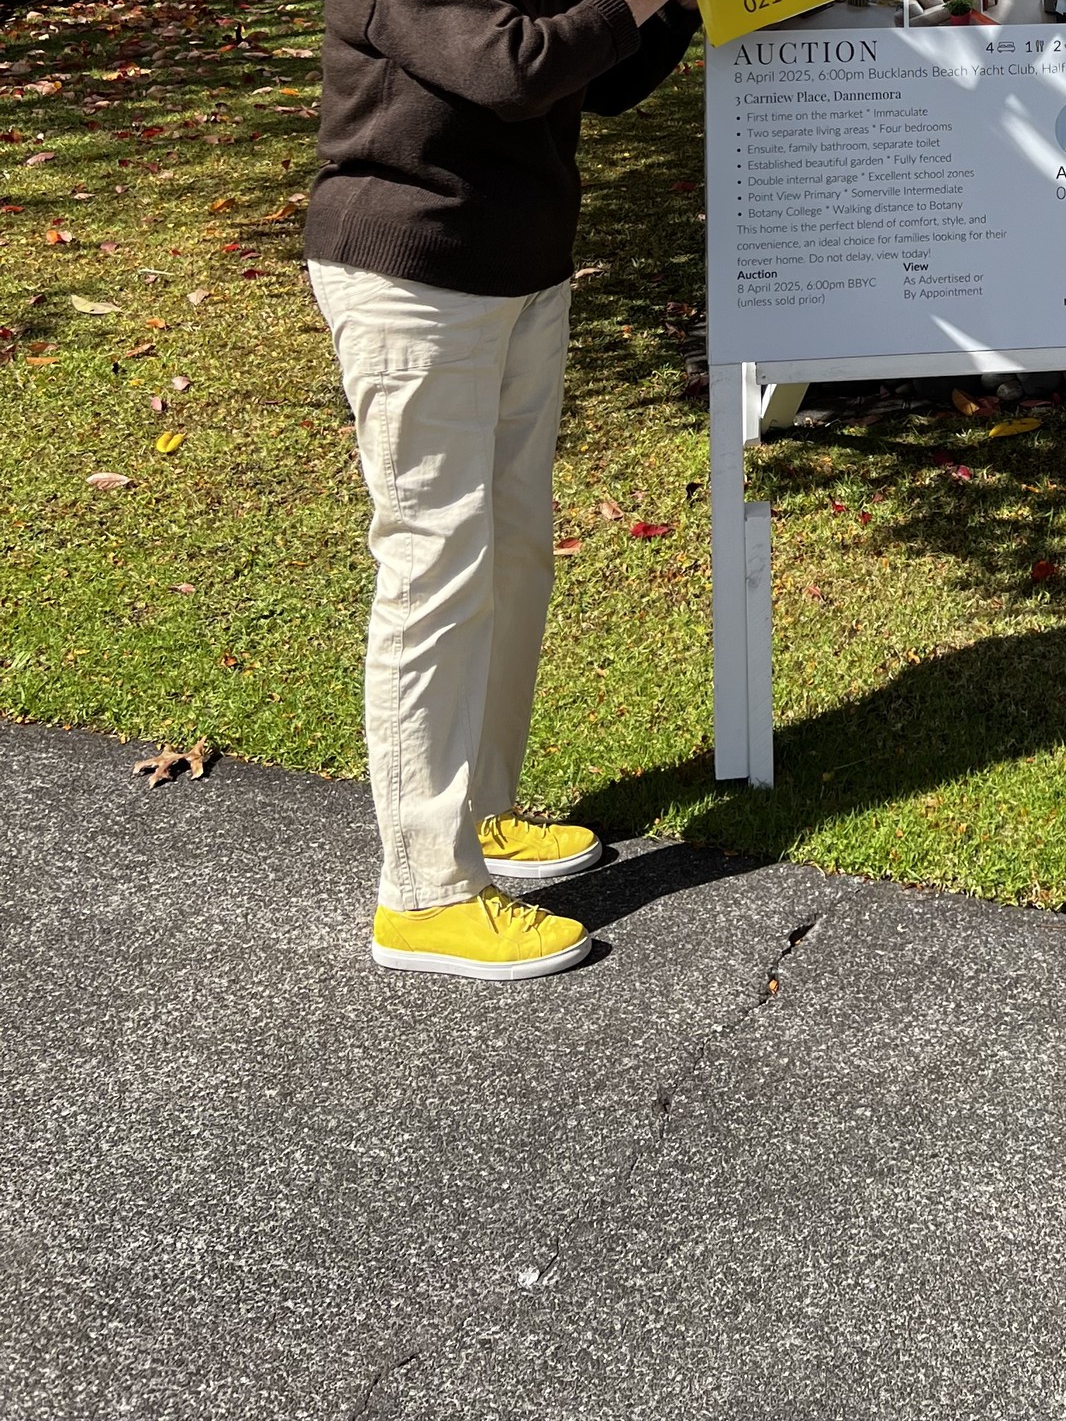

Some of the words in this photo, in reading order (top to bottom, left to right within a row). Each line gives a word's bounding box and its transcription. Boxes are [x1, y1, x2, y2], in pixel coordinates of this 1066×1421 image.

[733, 40, 878, 66] AUCTION
[985, 42, 994, 53] 4
[1025, 41, 1032, 53] 1
[1053, 40, 1061, 52] 2
[734, 72, 742, 83] 8
[746, 70, 774, 85] April
[778, 70, 814, 83] 2025,
[818, 68, 864, 83] 6:00pm
[868, 65, 928, 79] Bucklands
[932, 64, 967, 77] Beach
[971, 63, 1004, 76] Yacht
[1007, 62, 1038, 76] Club,
[1041, 61, 1065, 74] Half
[735, 96, 741, 107] 3
[743, 92, 793, 104] Carniew
[796, 90, 830, 104] Place,
[833, 89, 901, 101] Dannemora
[746, 111, 768, 122] First
[771, 110, 793, 121] time
[795, 112, 808, 120] on
[810, 109, 827, 120] the
[829, 108, 863, 119] market
[873, 106, 928, 117] Immaculate
[746, 127, 769, 138] Two
[771, 127, 813, 139] separate
[816, 124, 841, 138] living
[843, 126, 869, 134] areas
[879, 122, 902, 133] Four
[904, 120, 952, 132] bedrooms
[747, 142, 786, 155] Ensuite,
[788, 141, 817, 155] family
[820, 139, 870, 152] bathroom,
[872, 139, 913, 151] separate
[915, 136, 940, 148] toilet
[747, 158, 803, 170] Established
[805, 156, 848, 167] beautiful
[849, 154, 883, 168] garden
[893, 153, 917, 166] Fully
[919, 152, 952, 163] fenced
[747, 174, 784, 186] Double
[786, 173, 823, 184] internal
[825, 174, 858, 185] garage
[868, 169, 911, 181] Excellent
[913, 168, 944, 179] school
[946, 170, 975, 178] zones
[748, 190, 773, 202] Point
[776, 189, 801, 200] View
[803, 188, 841, 201] Primary
[851, 185, 901, 197] Somerville
[903, 183, 963, 195] Intermediate
[748, 207, 783, 220] Botany
[785, 205, 822, 218] College
[832, 202, 872, 216] Walking
[874, 201, 914, 212] distance
[916, 201, 927, 211] to
[929, 199, 963, 212] Botany
[736, 223, 757, 234] This
[759, 222, 788, 233] home
[790, 221, 798, 232] is
[800, 220, 817, 232] the
[819, 219, 854, 233] perfect
[856, 218, 884, 229] blend
[886, 217, 896, 228] of
[898, 215, 939, 228] comfort,
[941, 214, 966, 227] style,
[968, 213, 986, 224] and
[736, 238, 801, 251] convenience,
[803, 240, 816, 248] an
[818, 235, 841, 247] ideal
[843, 234, 875, 245] choice
[877, 233, 891, 244] for
[894, 231, 930, 243] families
[932, 230, 967, 243] looking
[968, 229, 983, 240] for
[985, 228, 1007, 239] their
[737, 254, 773, 266] forever
[809, 252, 824, 263] Do
[826, 252, 843, 262] not
[845, 250, 873, 263] delay,
[876, 248, 899, 260] view
[901, 247, 931, 261] today!
[902, 260, 929, 271] View
[736, 268, 777, 279] Auction
[903, 274, 916, 285] As
[918, 272, 971, 284] Advertised
[973, 274, 984, 282] or
[737, 283, 744, 294] 8
[746, 282, 771, 295] April
[806, 279, 845, 292] 6:00pm
[847, 277, 876, 288] BBYC
[903, 288, 916, 301] By
[919, 285, 982, 300] Appointment
[737, 296, 772, 309] (unless
[775, 294, 795, 305] sold
[798, 293, 825, 306] prior)
